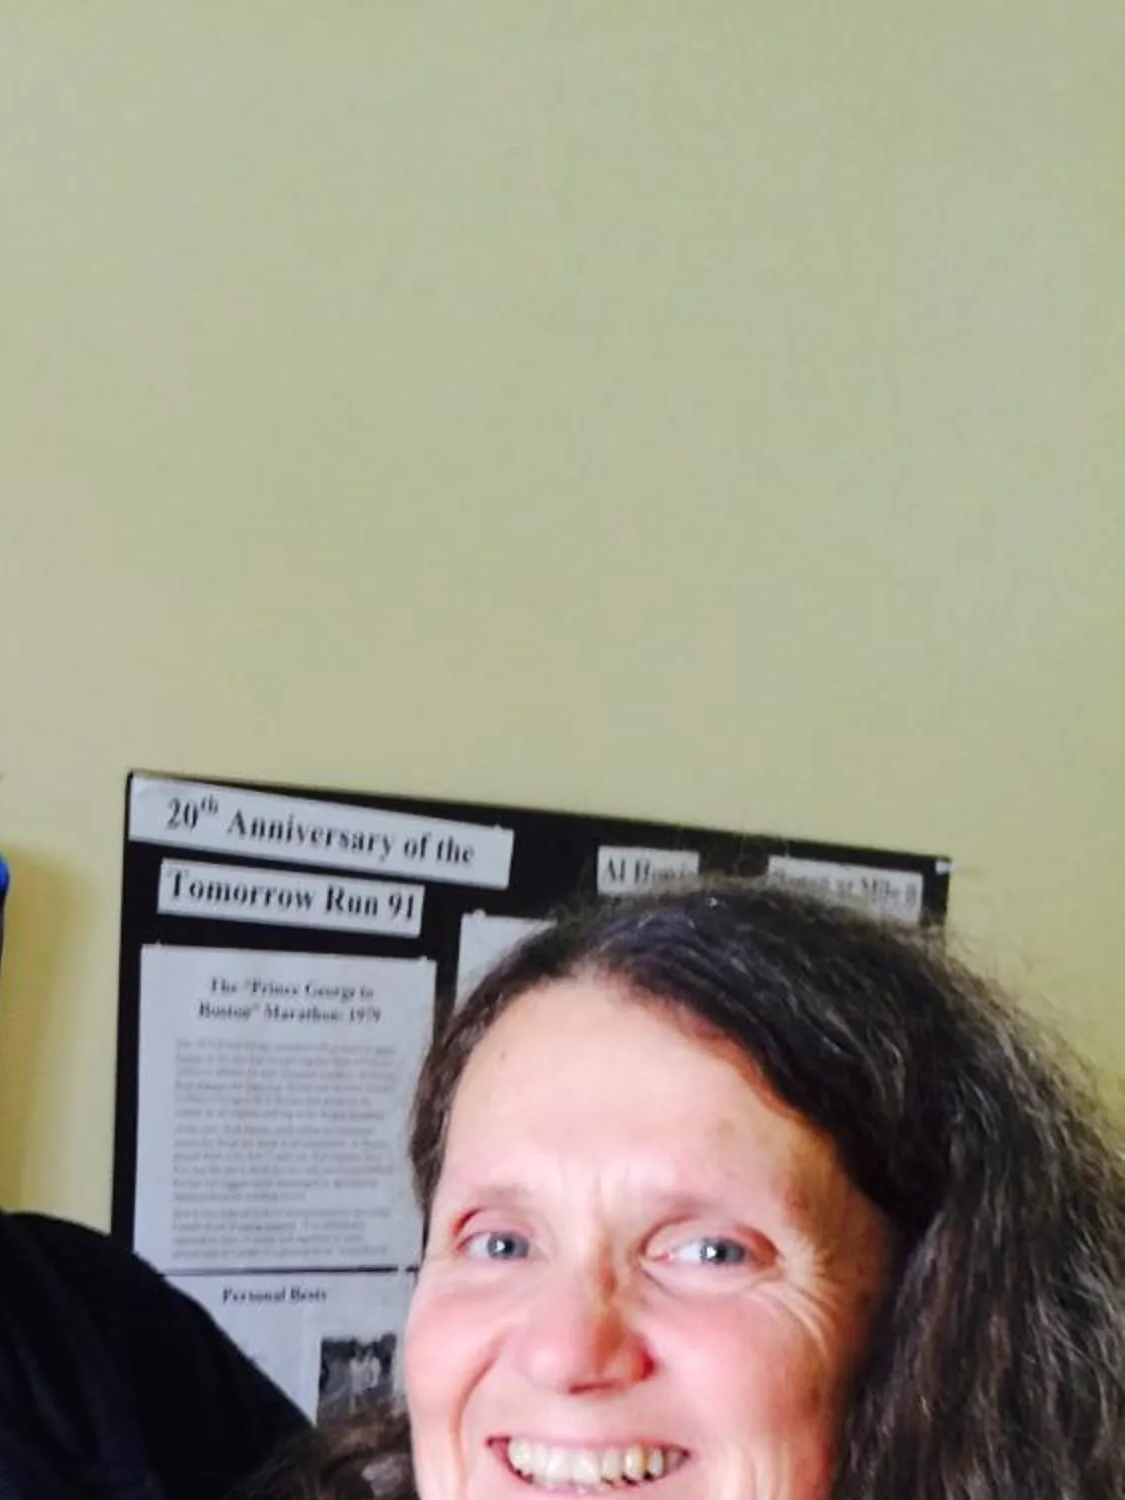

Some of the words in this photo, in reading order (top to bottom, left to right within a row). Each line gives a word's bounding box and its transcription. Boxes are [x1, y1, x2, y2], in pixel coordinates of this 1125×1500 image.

[227, 808, 393, 860] Anniversary
[404, 834, 428, 859] of
[437, 835, 475, 865] the
[166, 868, 315, 910] Tomorrow
[326, 884, 379, 917] Run
[388, 892, 415, 922] 91
